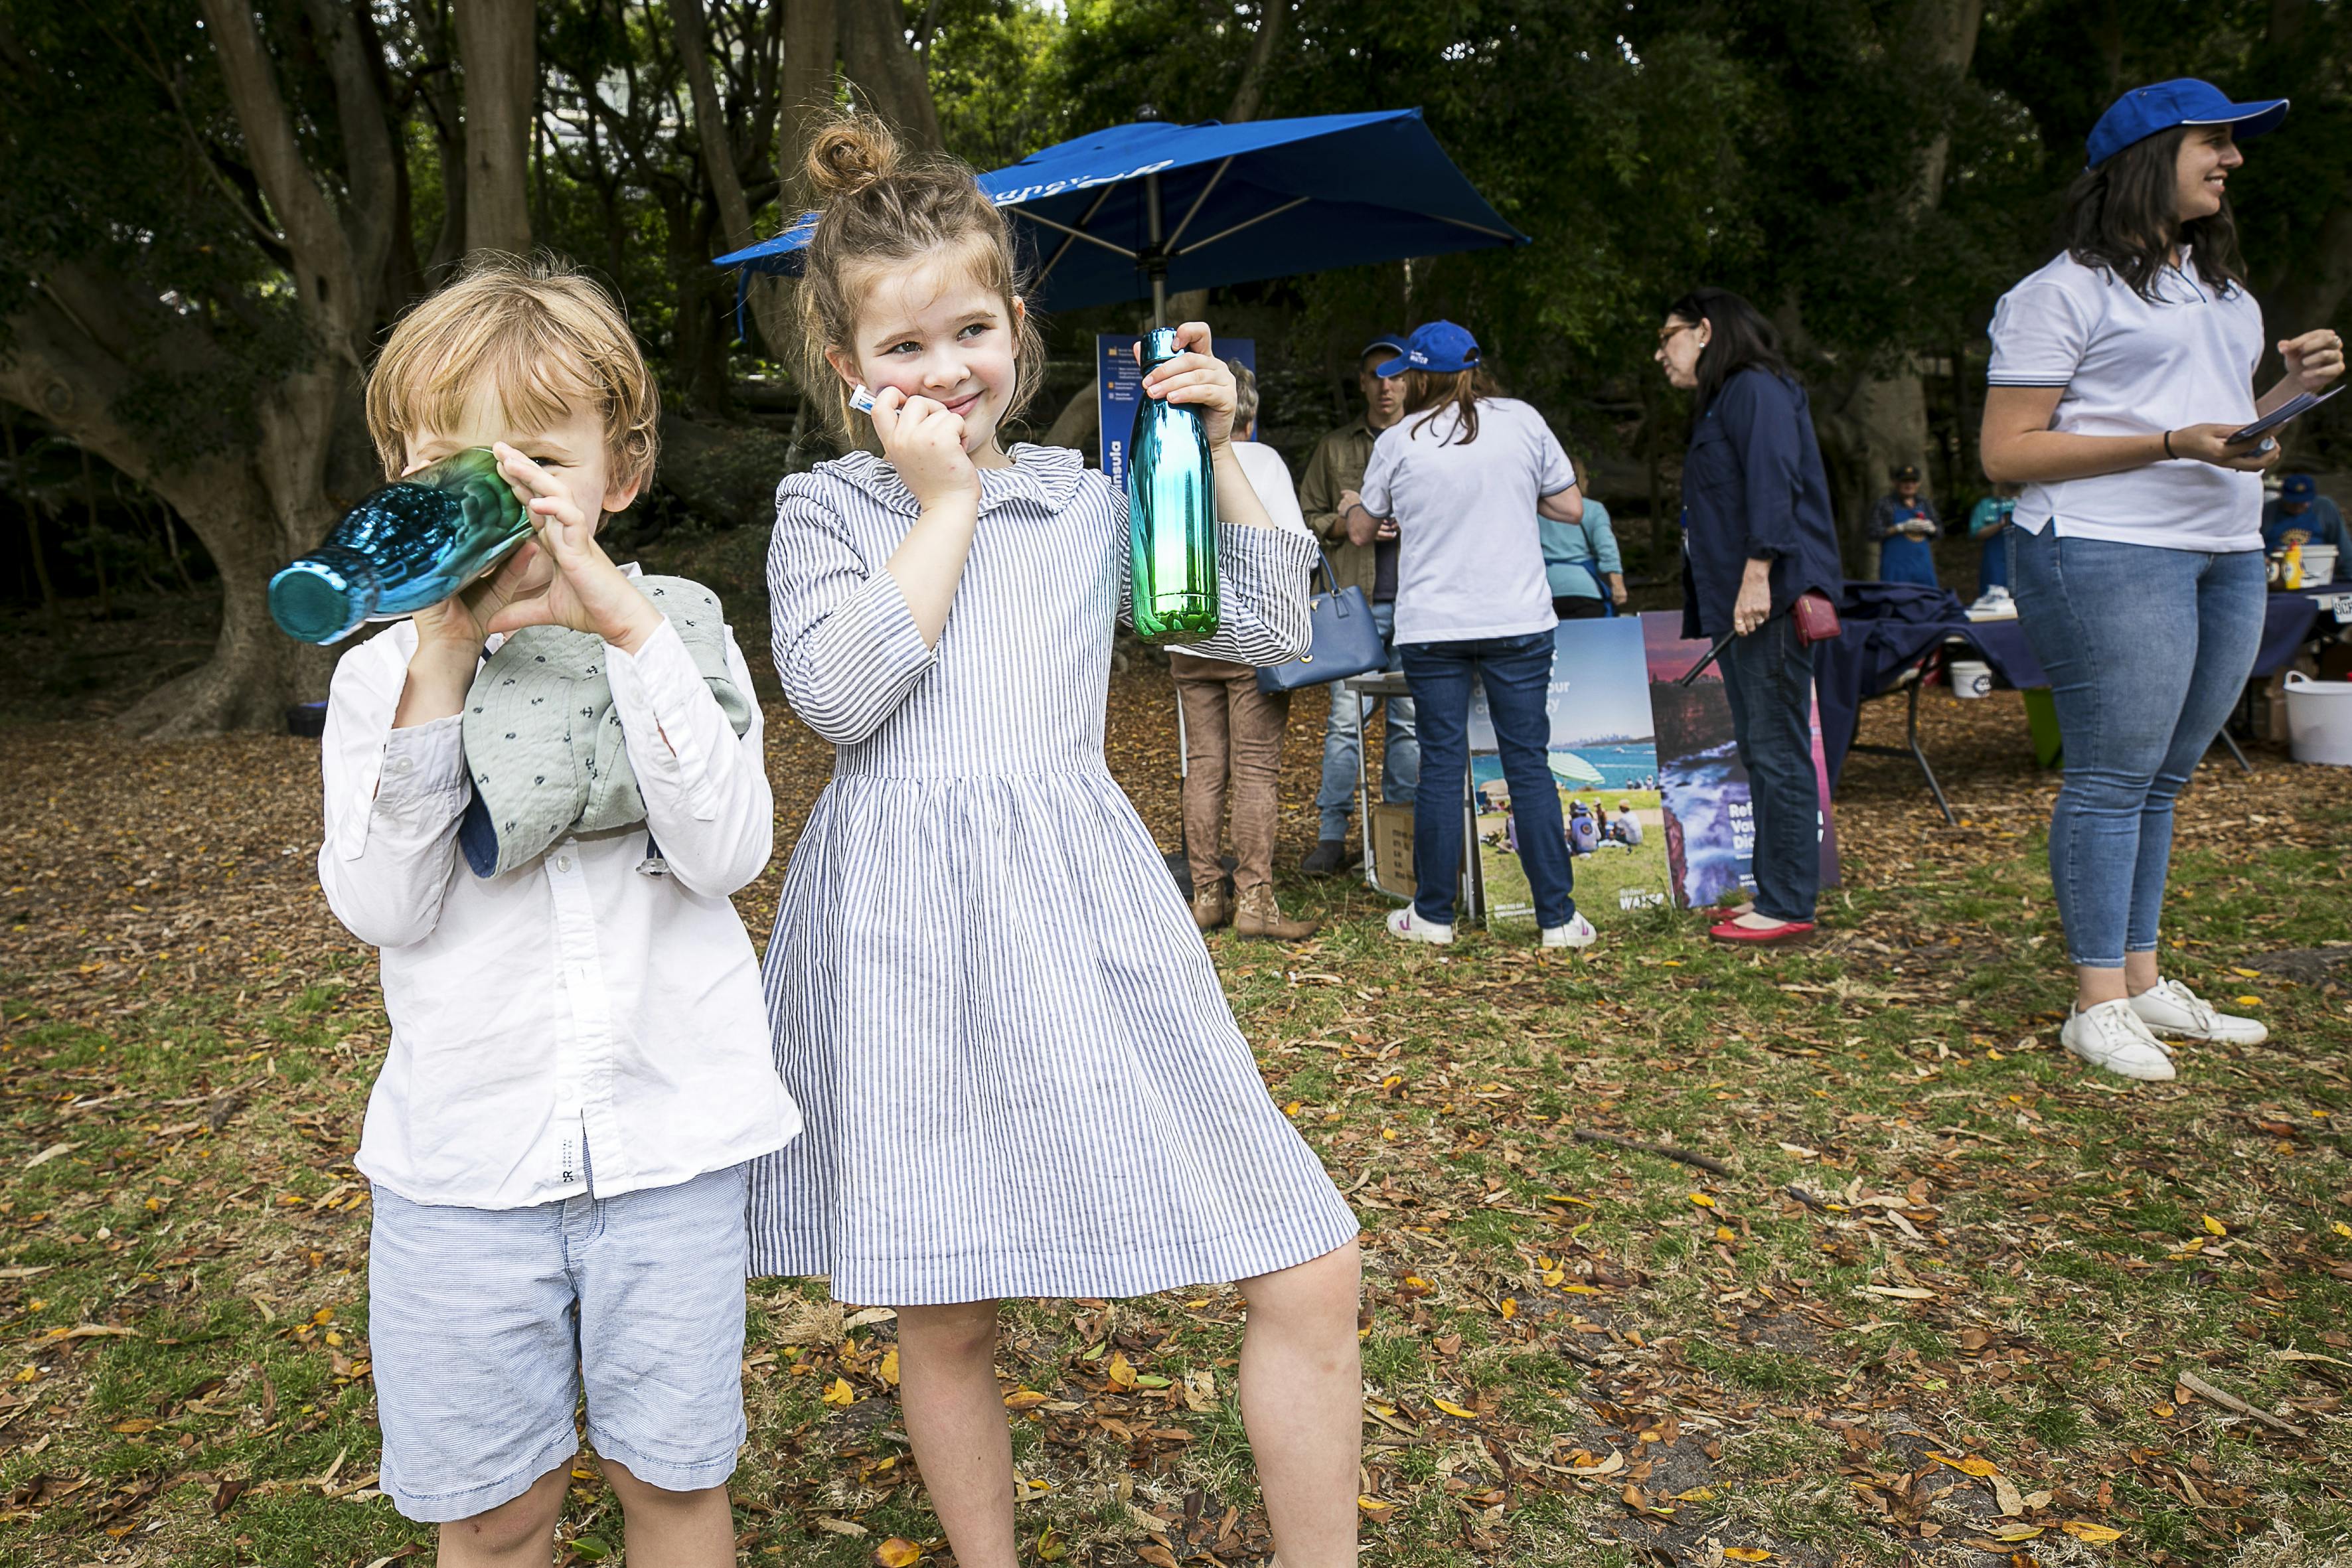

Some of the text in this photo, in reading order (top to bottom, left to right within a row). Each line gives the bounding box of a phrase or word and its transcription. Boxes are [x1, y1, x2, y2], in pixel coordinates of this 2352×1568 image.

[1110, 441, 1122, 489] insula
[1729, 801, 1753, 817] Ref
[1730, 820, 1755, 833] Vau
